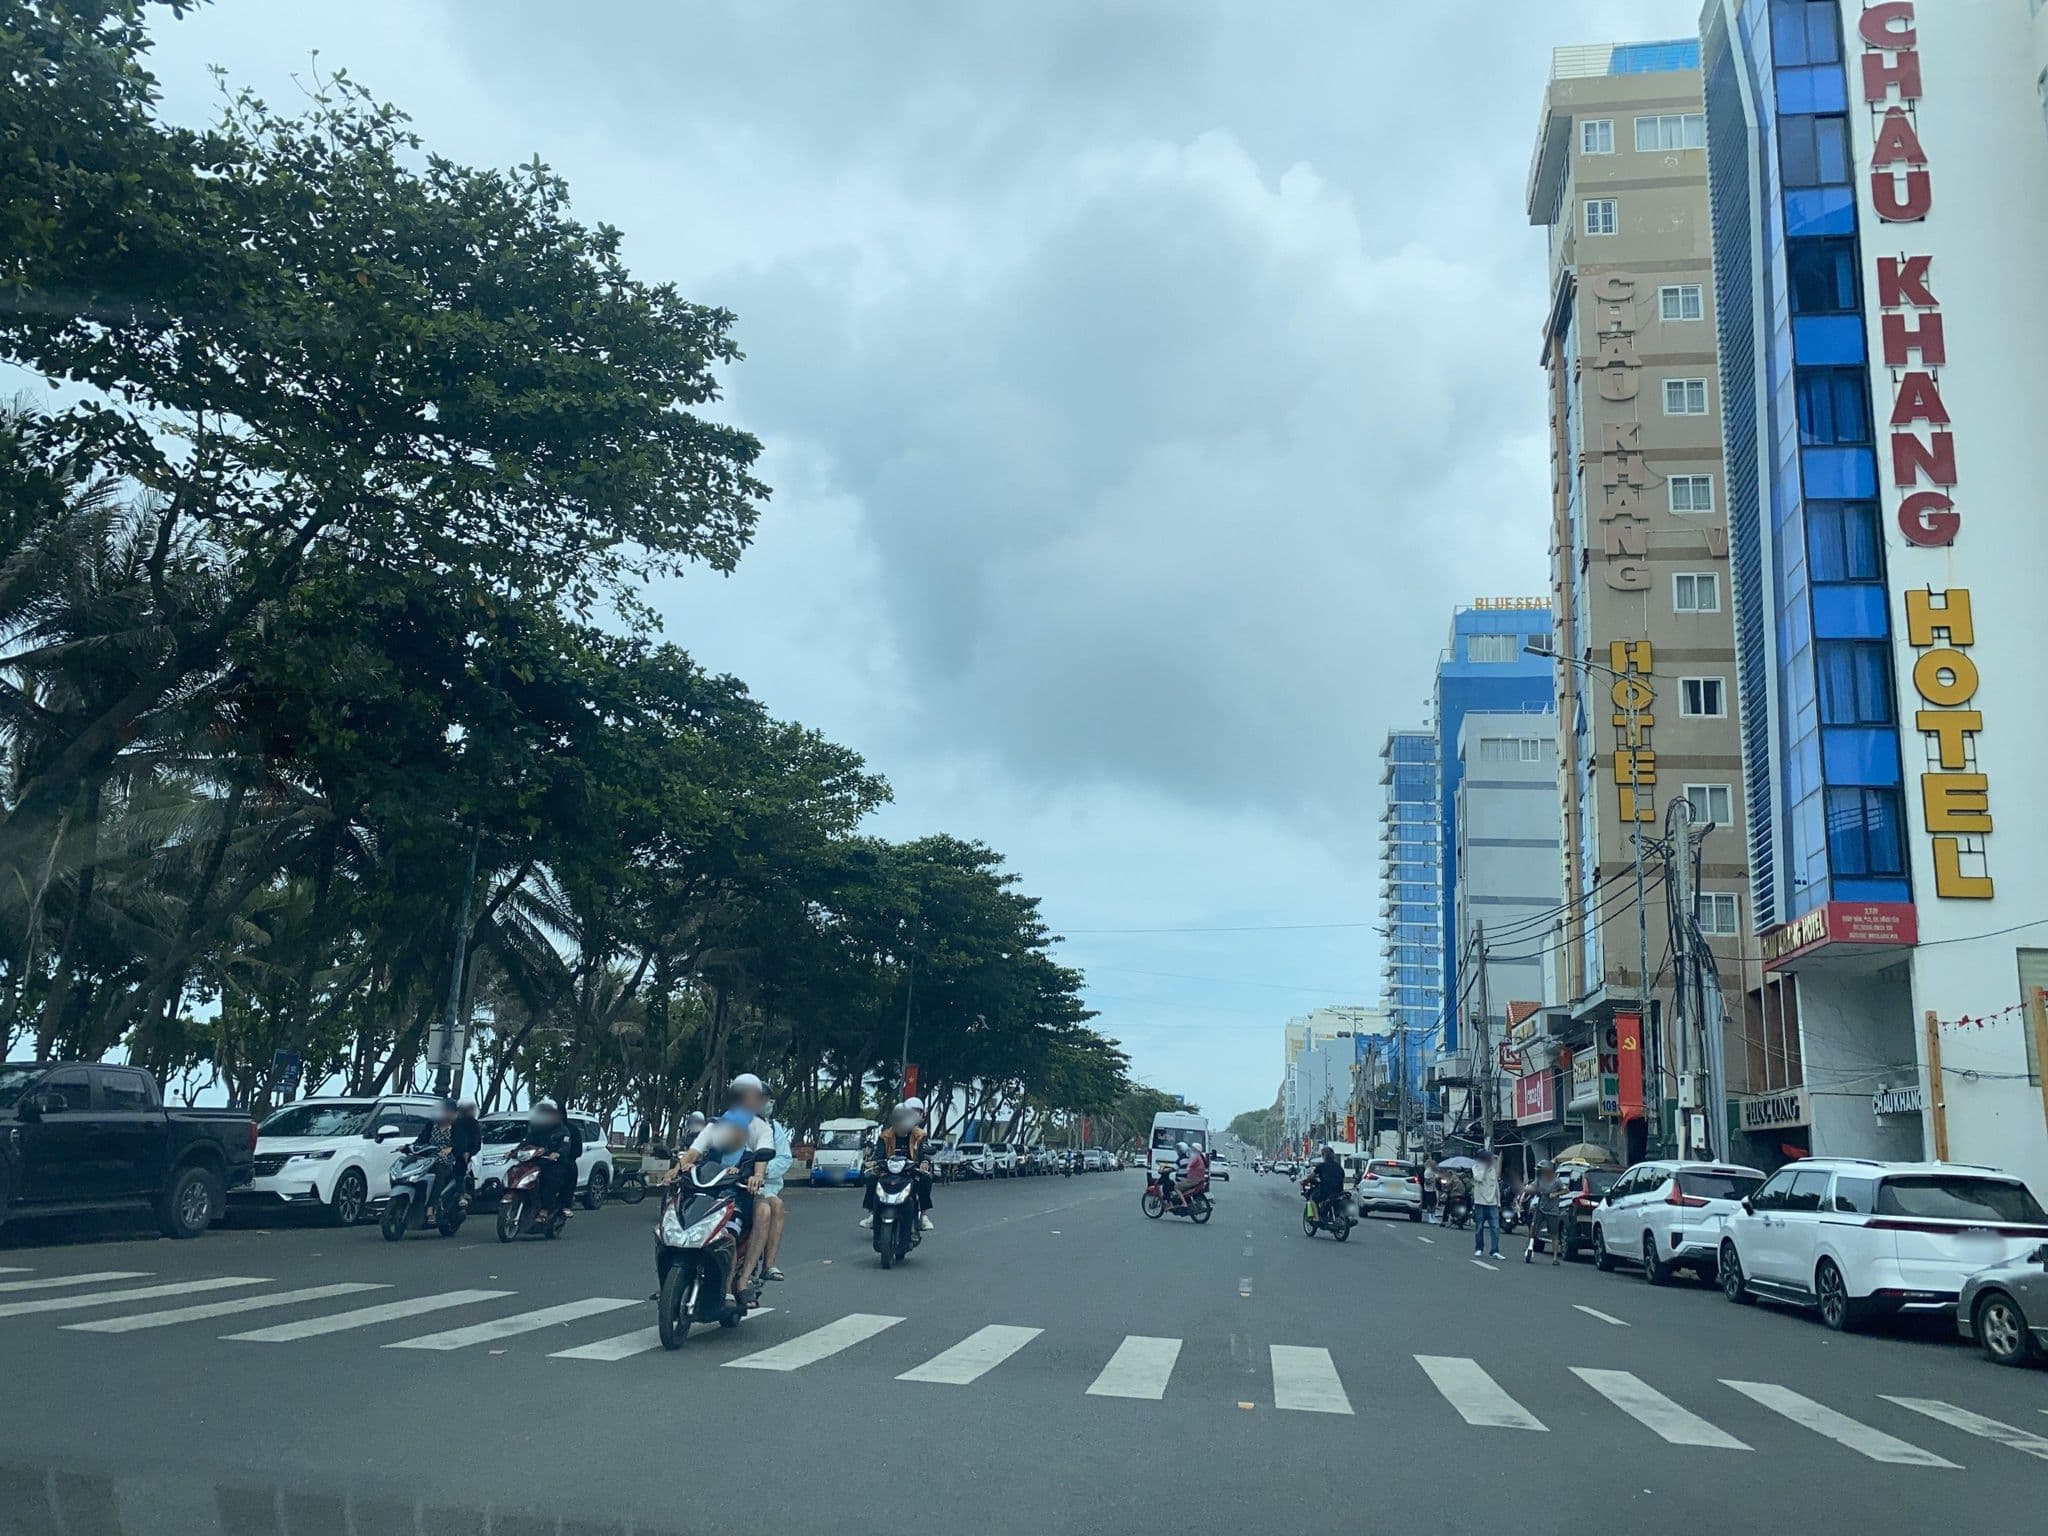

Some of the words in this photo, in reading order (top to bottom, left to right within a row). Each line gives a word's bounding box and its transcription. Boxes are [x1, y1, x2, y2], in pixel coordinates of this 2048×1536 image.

[1859, 1, 1932, 222] CHAU
[1593, 271, 1641, 402] CHAU
[1876, 255, 1961, 548] KHANG
[1599, 422, 1652, 592] KHANG
[1475, 597, 1513, 610] BLUE
[1516, 597, 1543, 610] SEA
[1610, 640, 1656, 823] HOTEL
[1904, 588, 1994, 900] HOTEL
[1801, 909, 1826, 945] HOTEL
[1602, 1100, 1617, 1112] 109
